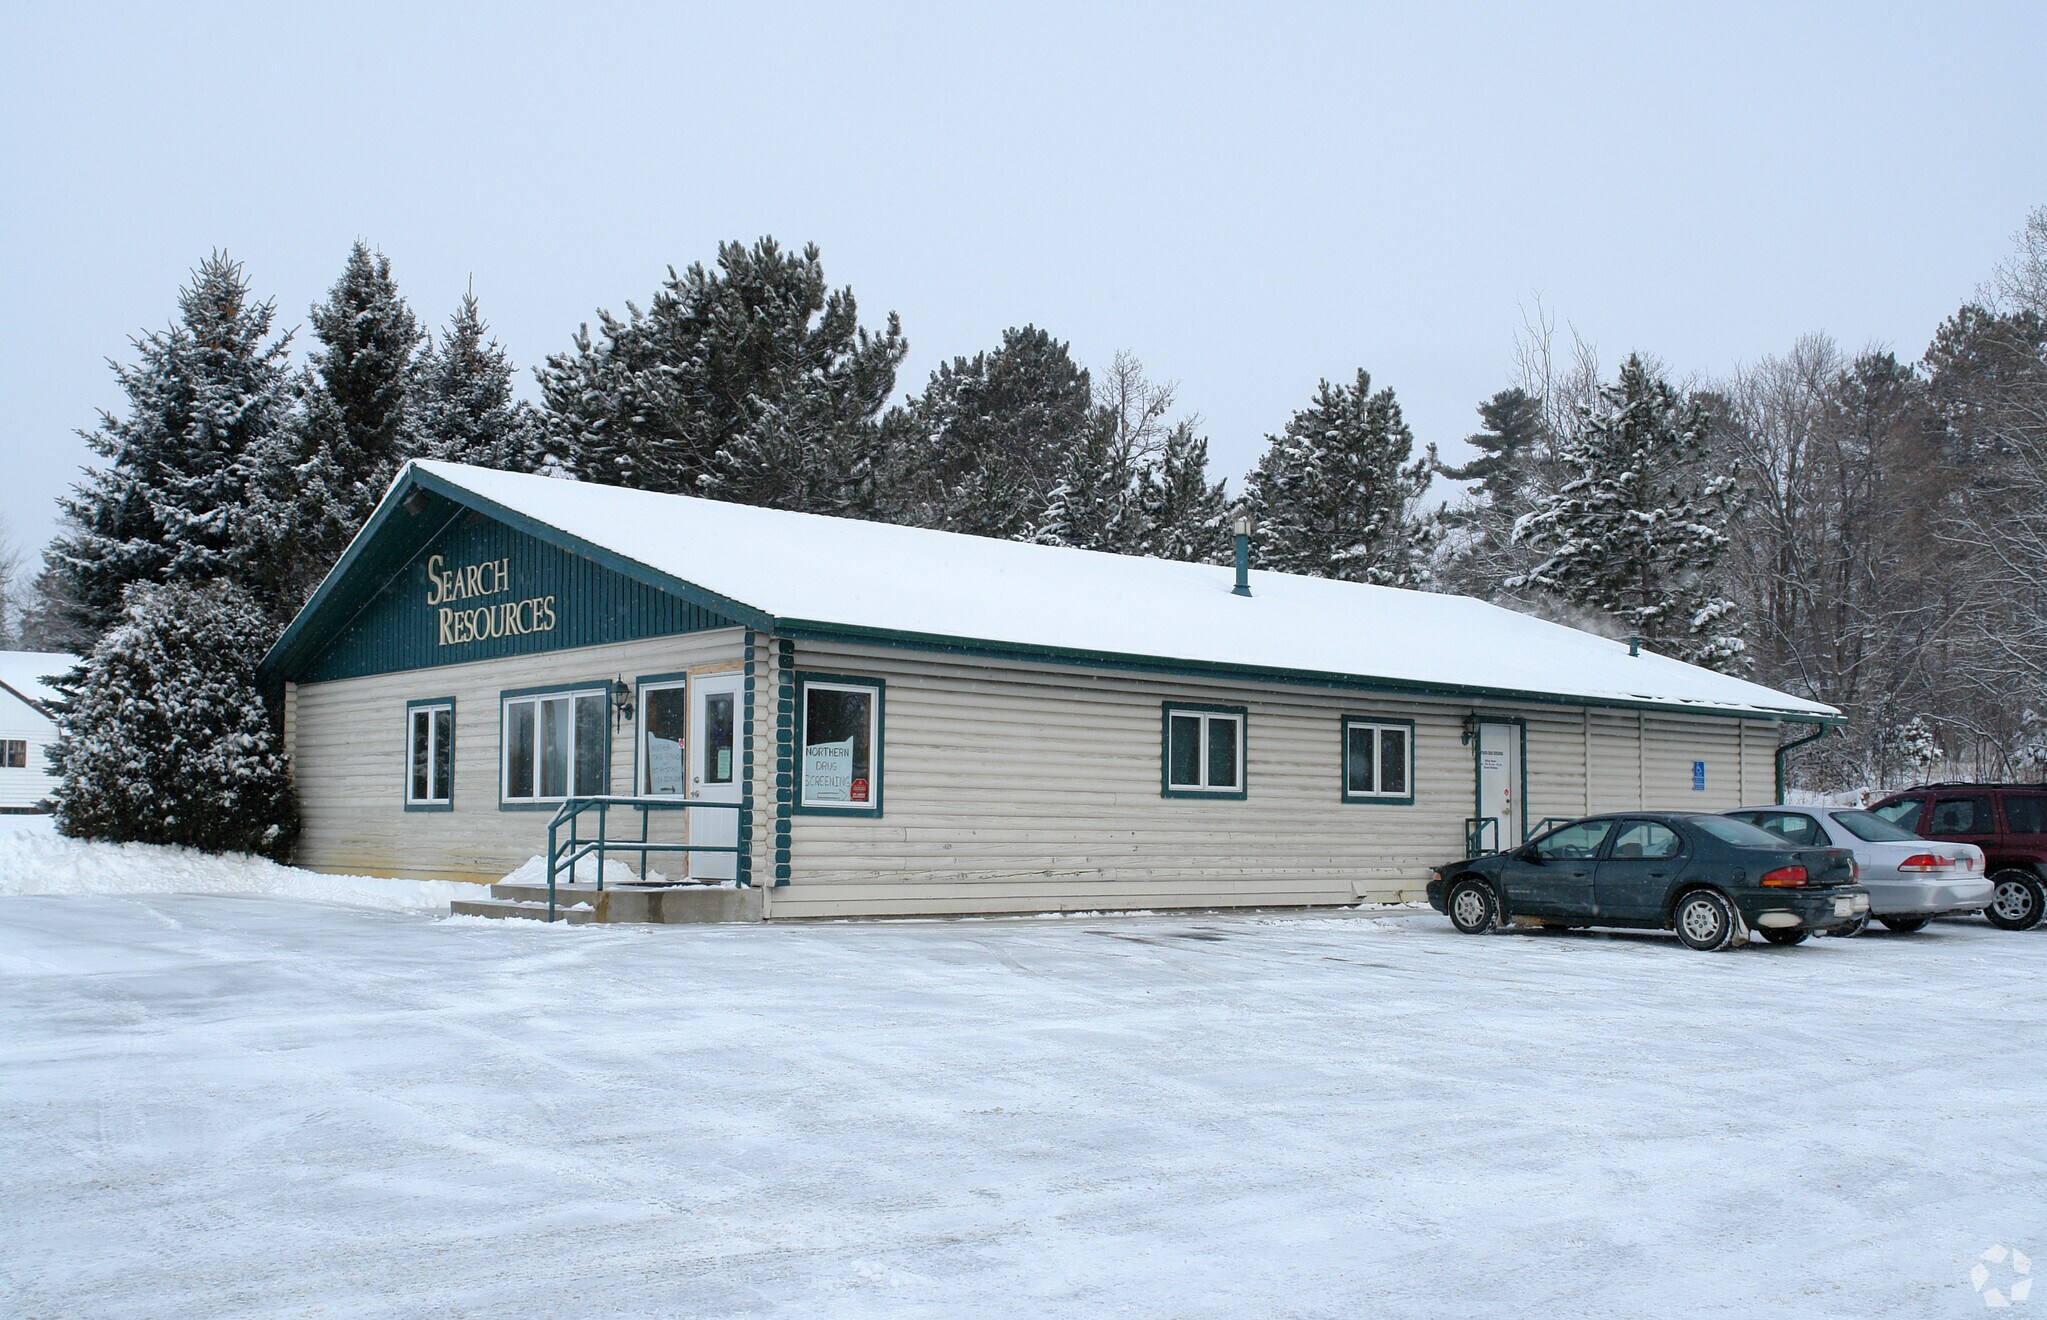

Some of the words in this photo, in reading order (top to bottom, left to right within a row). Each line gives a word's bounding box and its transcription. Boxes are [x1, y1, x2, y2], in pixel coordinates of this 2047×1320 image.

[427, 554, 510, 606] SEARCH
[438, 595, 557, 646] RESOURCES
[806, 747, 849, 757] NORTHERN
[816, 761, 837, 770] DRUG
[805, 775, 850, 787] SCREENING
